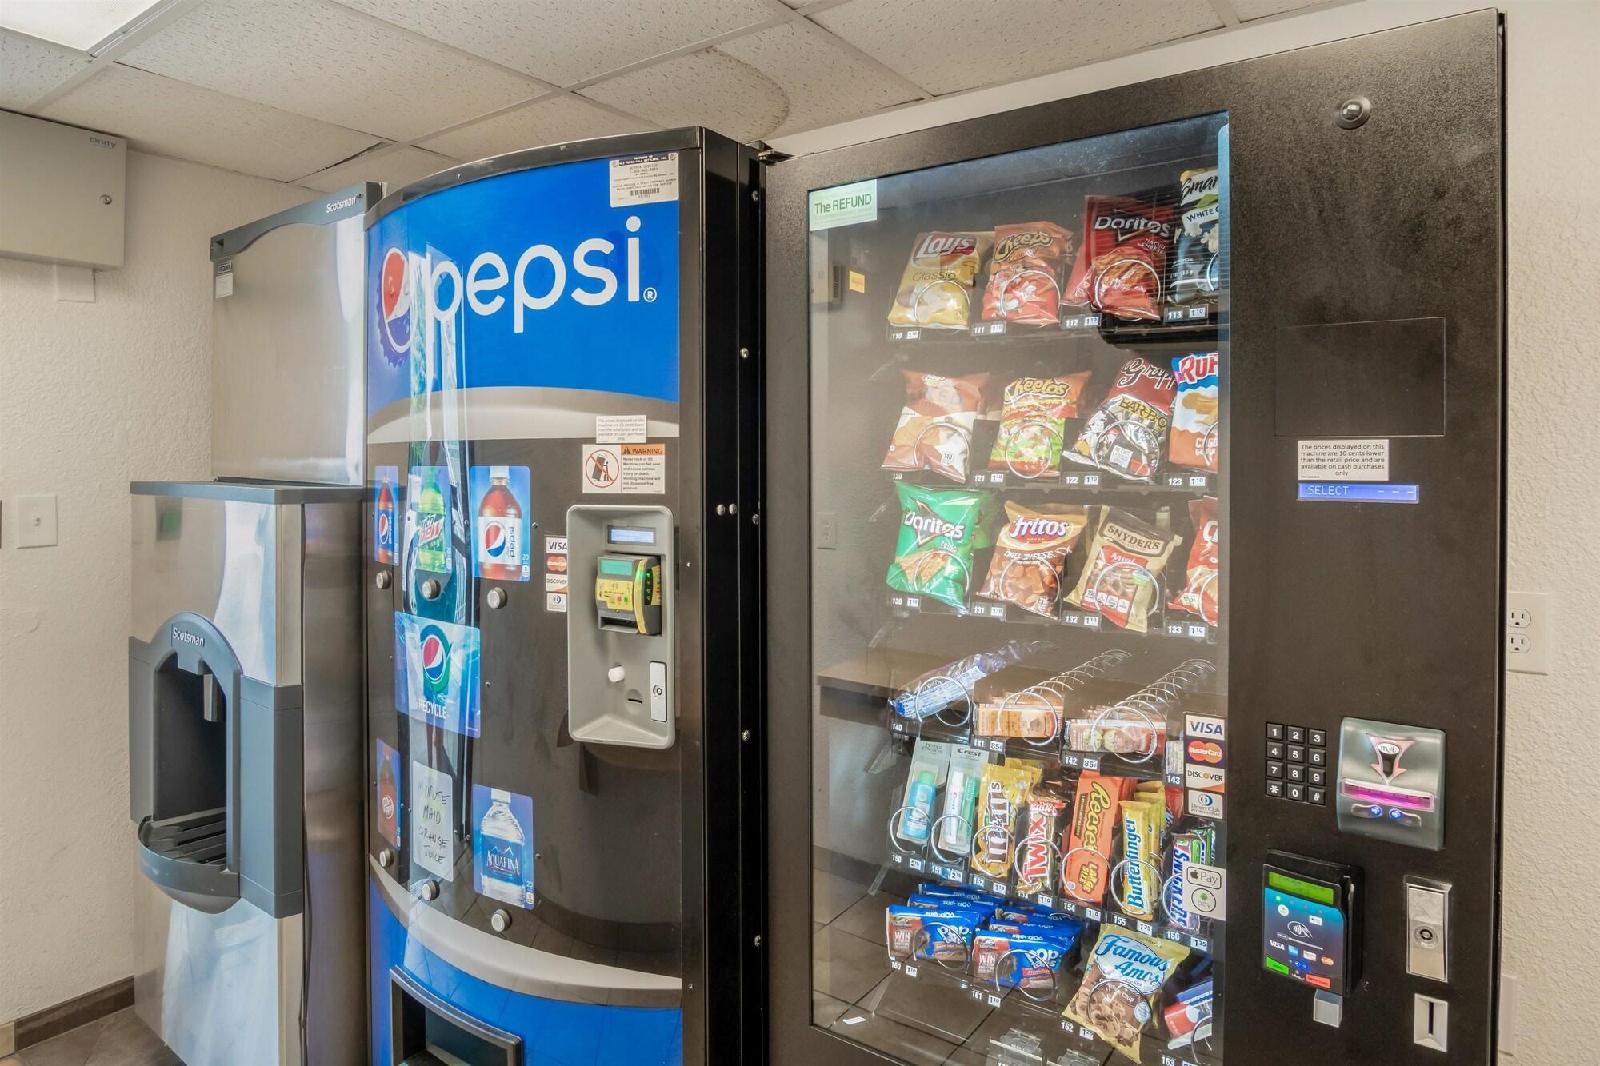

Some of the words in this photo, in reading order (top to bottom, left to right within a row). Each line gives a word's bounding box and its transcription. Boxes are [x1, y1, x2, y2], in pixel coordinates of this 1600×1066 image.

[814, 203, 831, 214] The
[833, 194, 871, 211] REFUND
[1186, 208, 1214, 222] WHITE
[1094, 216, 1171, 238] Doritos
[426, 215, 642, 335] pepsi
[913, 272, 956, 282] Classic
[1168, 311, 1183, 319] 113
[1004, 377, 1070, 404] Cheetos
[1066, 476, 1079, 484] 122
[1168, 477, 1182, 486] 123
[1307, 485, 1350, 495] SELECT
[904, 511, 964, 540] Doritos
[549, 541, 567, 550] VISA
[173, 627, 205, 647] Scotsman
[1190, 720, 1223, 736] VISA
[1272, 728, 1277, 736] 1
[1292, 731, 1299, 739] 2
[1313, 734, 1320, 742] 3
[1065, 756, 1078, 765] 142
[1271, 747, 1278, 755] 4
[1292, 750, 1298, 759] 5
[1313, 754, 1320, 762] 6
[1167, 775, 1180, 784] 143
[1187, 769, 1223, 782] DISCOVER
[1271, 766, 1278, 775] 7
[1292, 770, 1299, 778] 8
[1313, 773, 1319, 782] 9
[1292, 789, 1299, 797] 0
[422, 805, 441, 825] MAID
[1123, 817, 1144, 909] Butterfinger
[1200, 872, 1218, 884] Pay
[1064, 902, 1075, 912] 154
[1114, 916, 1127, 926] 155
[1269, 939, 1285, 951] VISA
[1095, 934, 1170, 972] Famous
[1114, 961, 1162, 985] Amos
